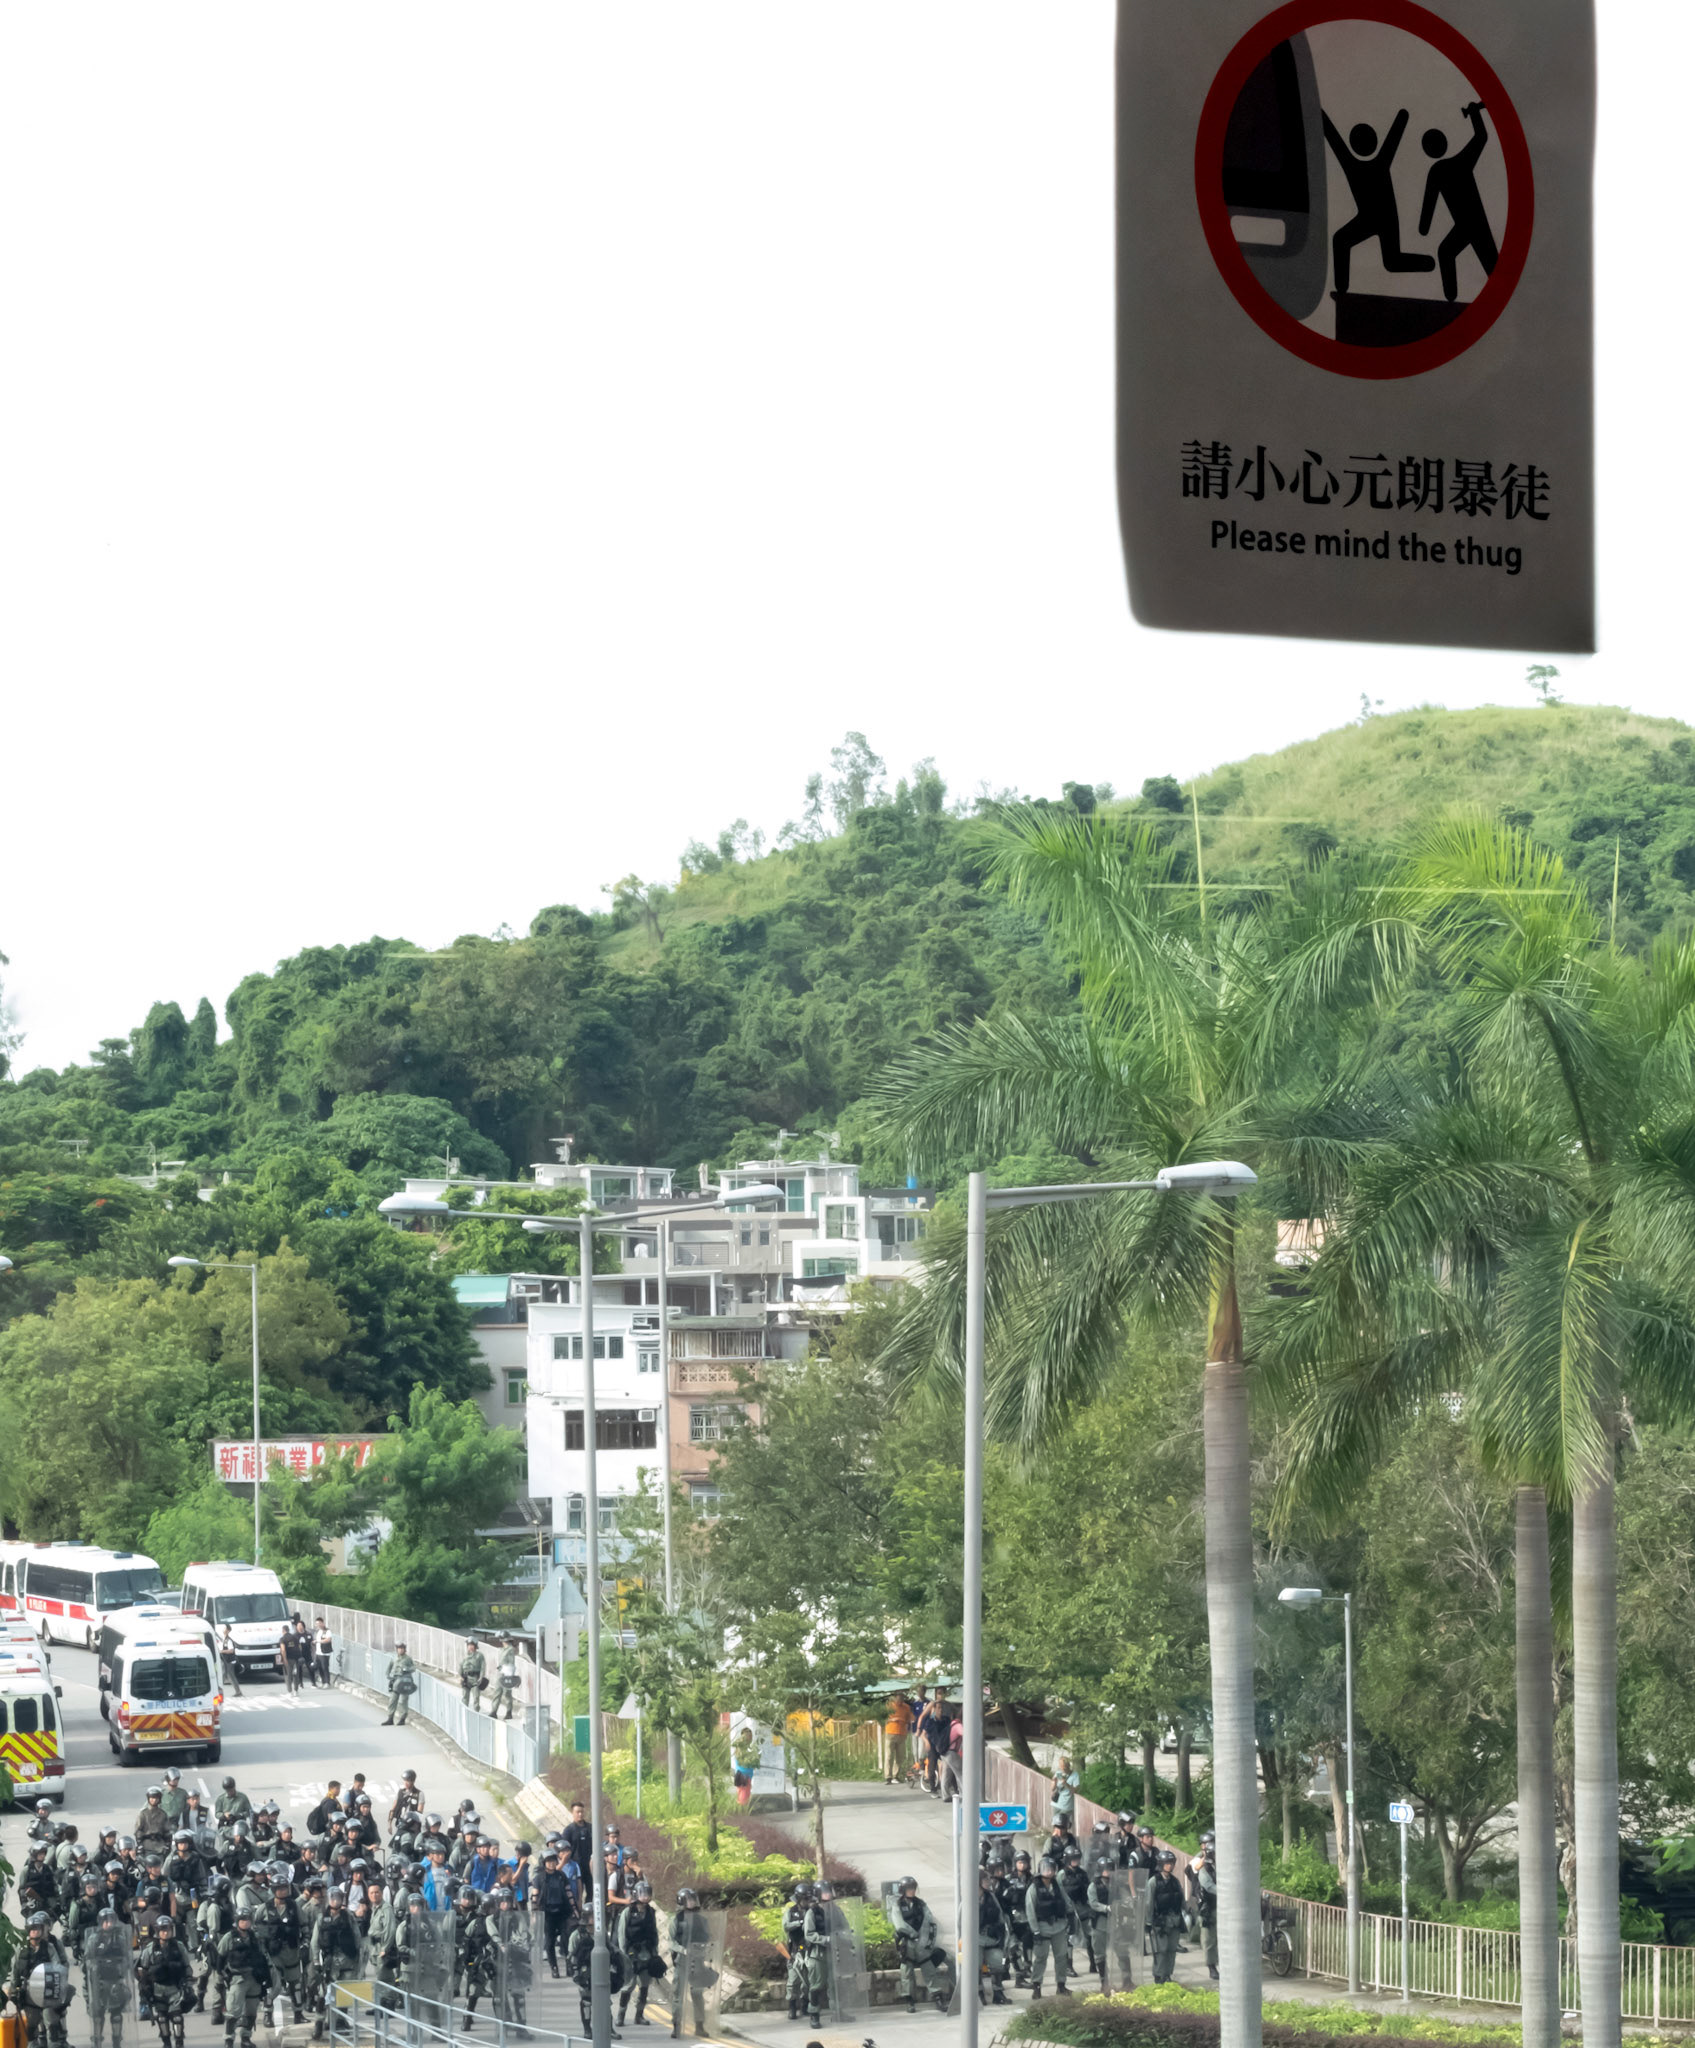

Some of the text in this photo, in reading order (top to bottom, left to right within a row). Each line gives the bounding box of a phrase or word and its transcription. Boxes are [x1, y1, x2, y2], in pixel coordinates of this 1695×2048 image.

[1180, 439, 1551, 521] 請小心元朗暴徒
[1211, 520, 1522, 576] Please mind the thug
[155, 1700, 188, 1709] POLICE
